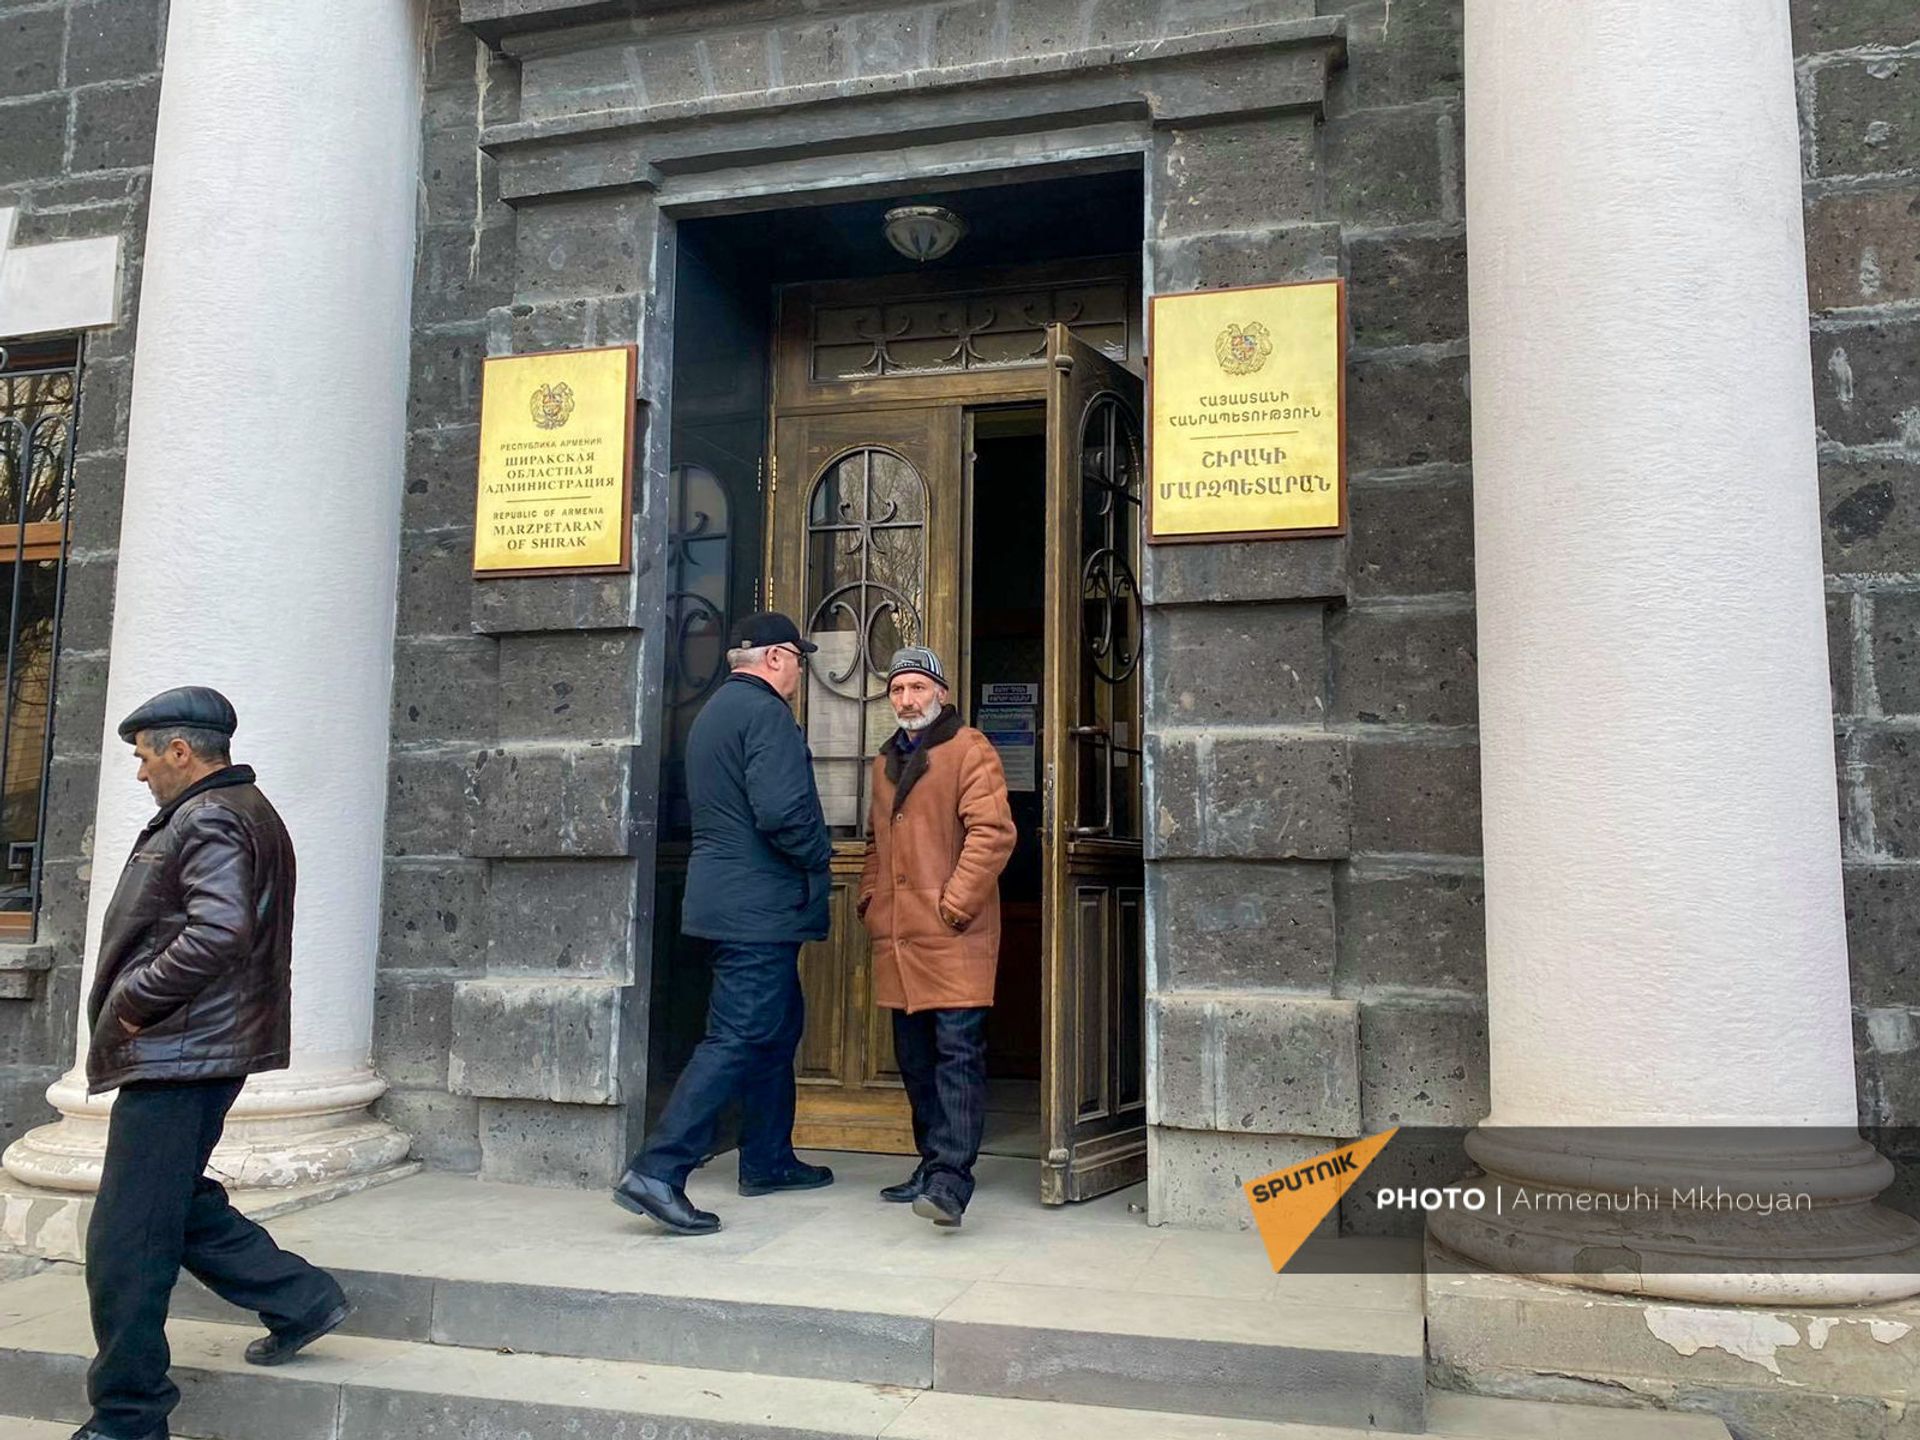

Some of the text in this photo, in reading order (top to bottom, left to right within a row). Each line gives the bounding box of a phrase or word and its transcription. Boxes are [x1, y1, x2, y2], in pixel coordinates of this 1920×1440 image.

[1200, 391, 1289, 407] ՀԱՅԱՍՏԱՆԻ
[1169, 407, 1321, 427] ՀԱՆՐԱՊԵՏՈՒԹՅՈՒՆ
[500, 438, 602, 451] РЕСПУБЛИКА АРМЕНИЯ
[505, 452, 595, 466] ШИРАКСКАЯ
[1202, 447, 1287, 469] ՇԻՐԱԿԻ
[507, 465, 593, 479] ОБЛАСТНАЯ
[486, 477, 615, 493] АДМИНИСТРАЦИЯ
[1160, 475, 1331, 500] ՄԱՐԶՊԵՏԱՐԱՆ
[493, 507, 604, 520] REPUBLIC OF ARMENIA
[493, 520, 603, 536] MARZPETARAN
[507, 536, 587, 550] OF SHIRAK
